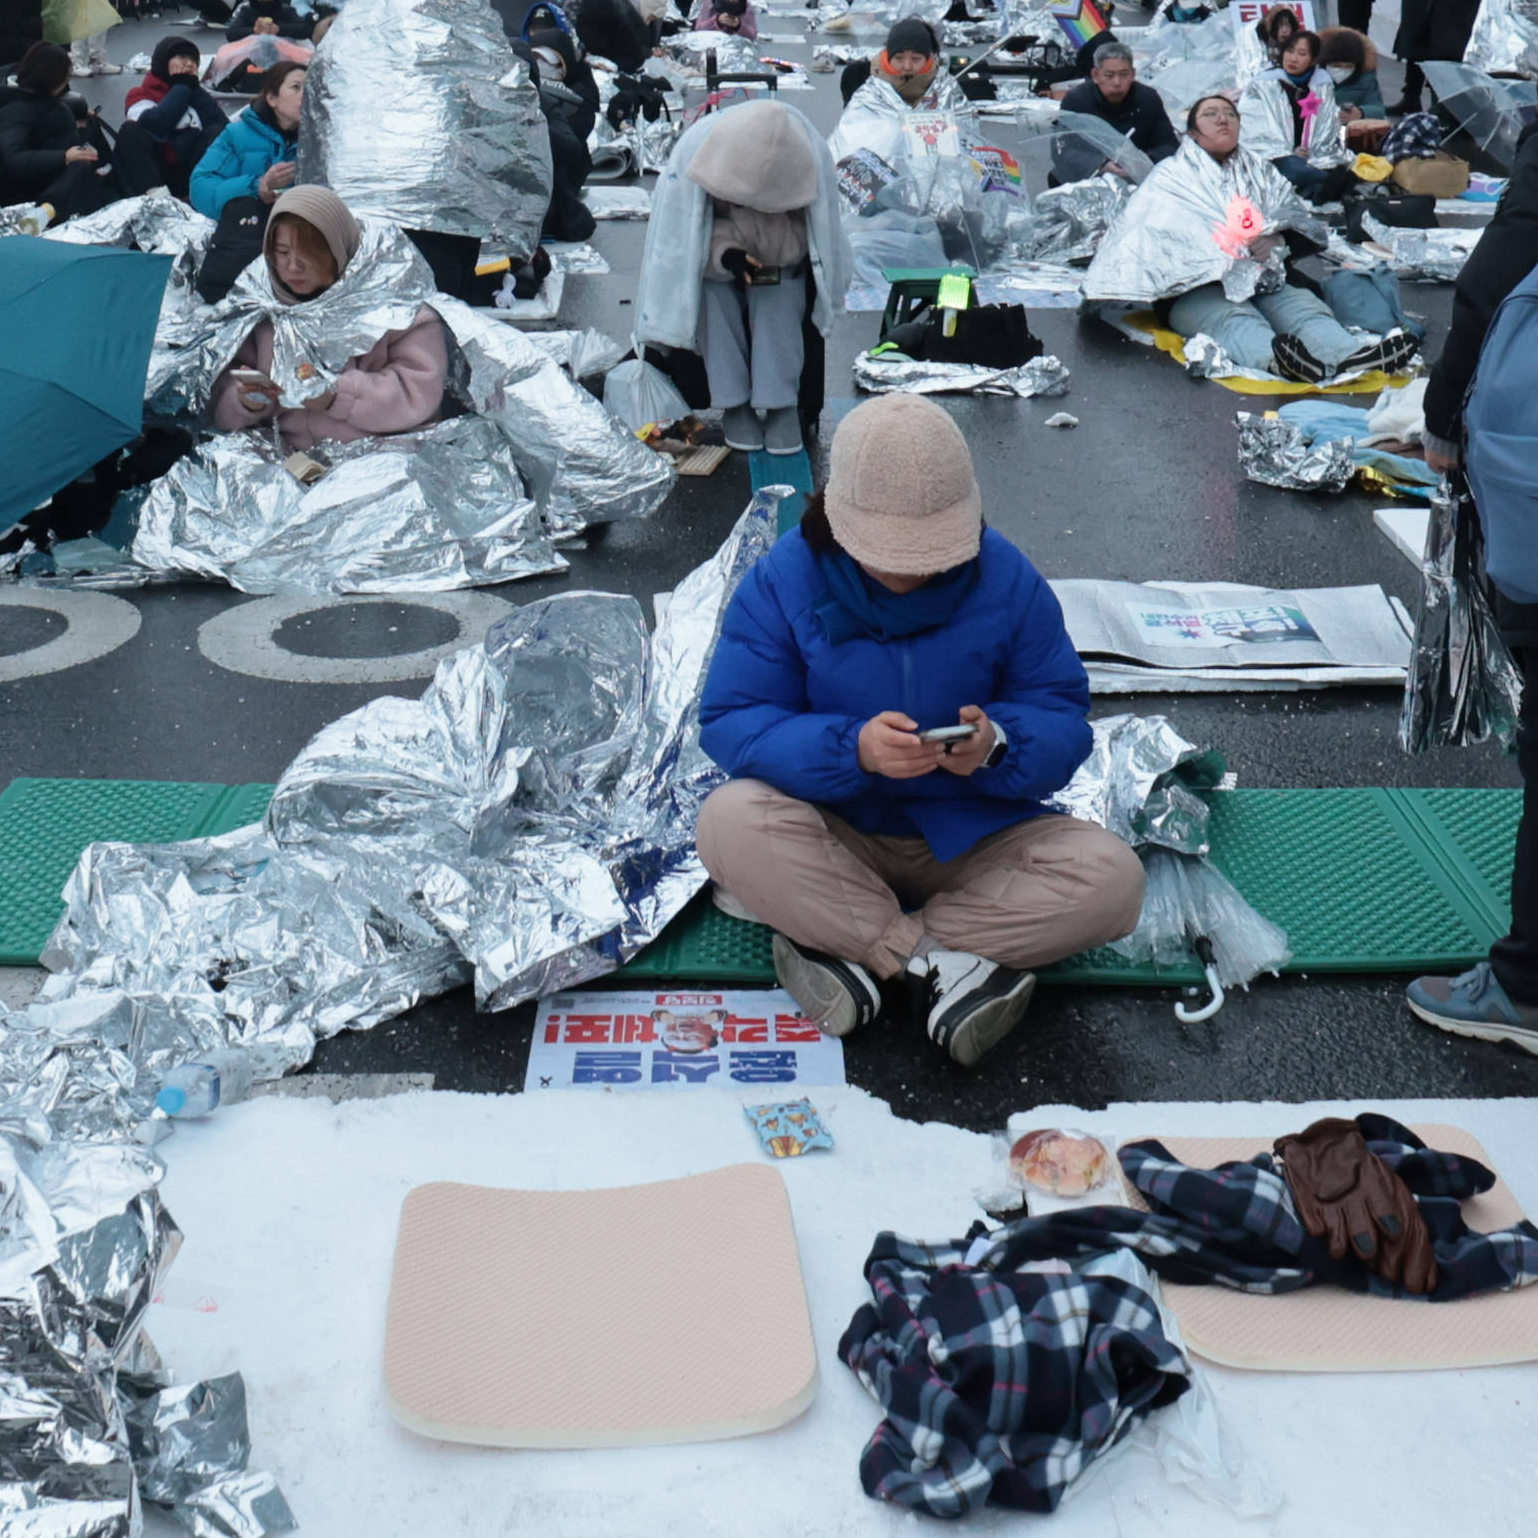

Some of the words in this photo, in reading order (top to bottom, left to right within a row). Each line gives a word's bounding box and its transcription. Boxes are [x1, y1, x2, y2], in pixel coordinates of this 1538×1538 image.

[543, 1014, 659, 1044] 체포!
[722, 1013, 822, 1044] 즉각
[572, 1050, 798, 1084] 윤석열
